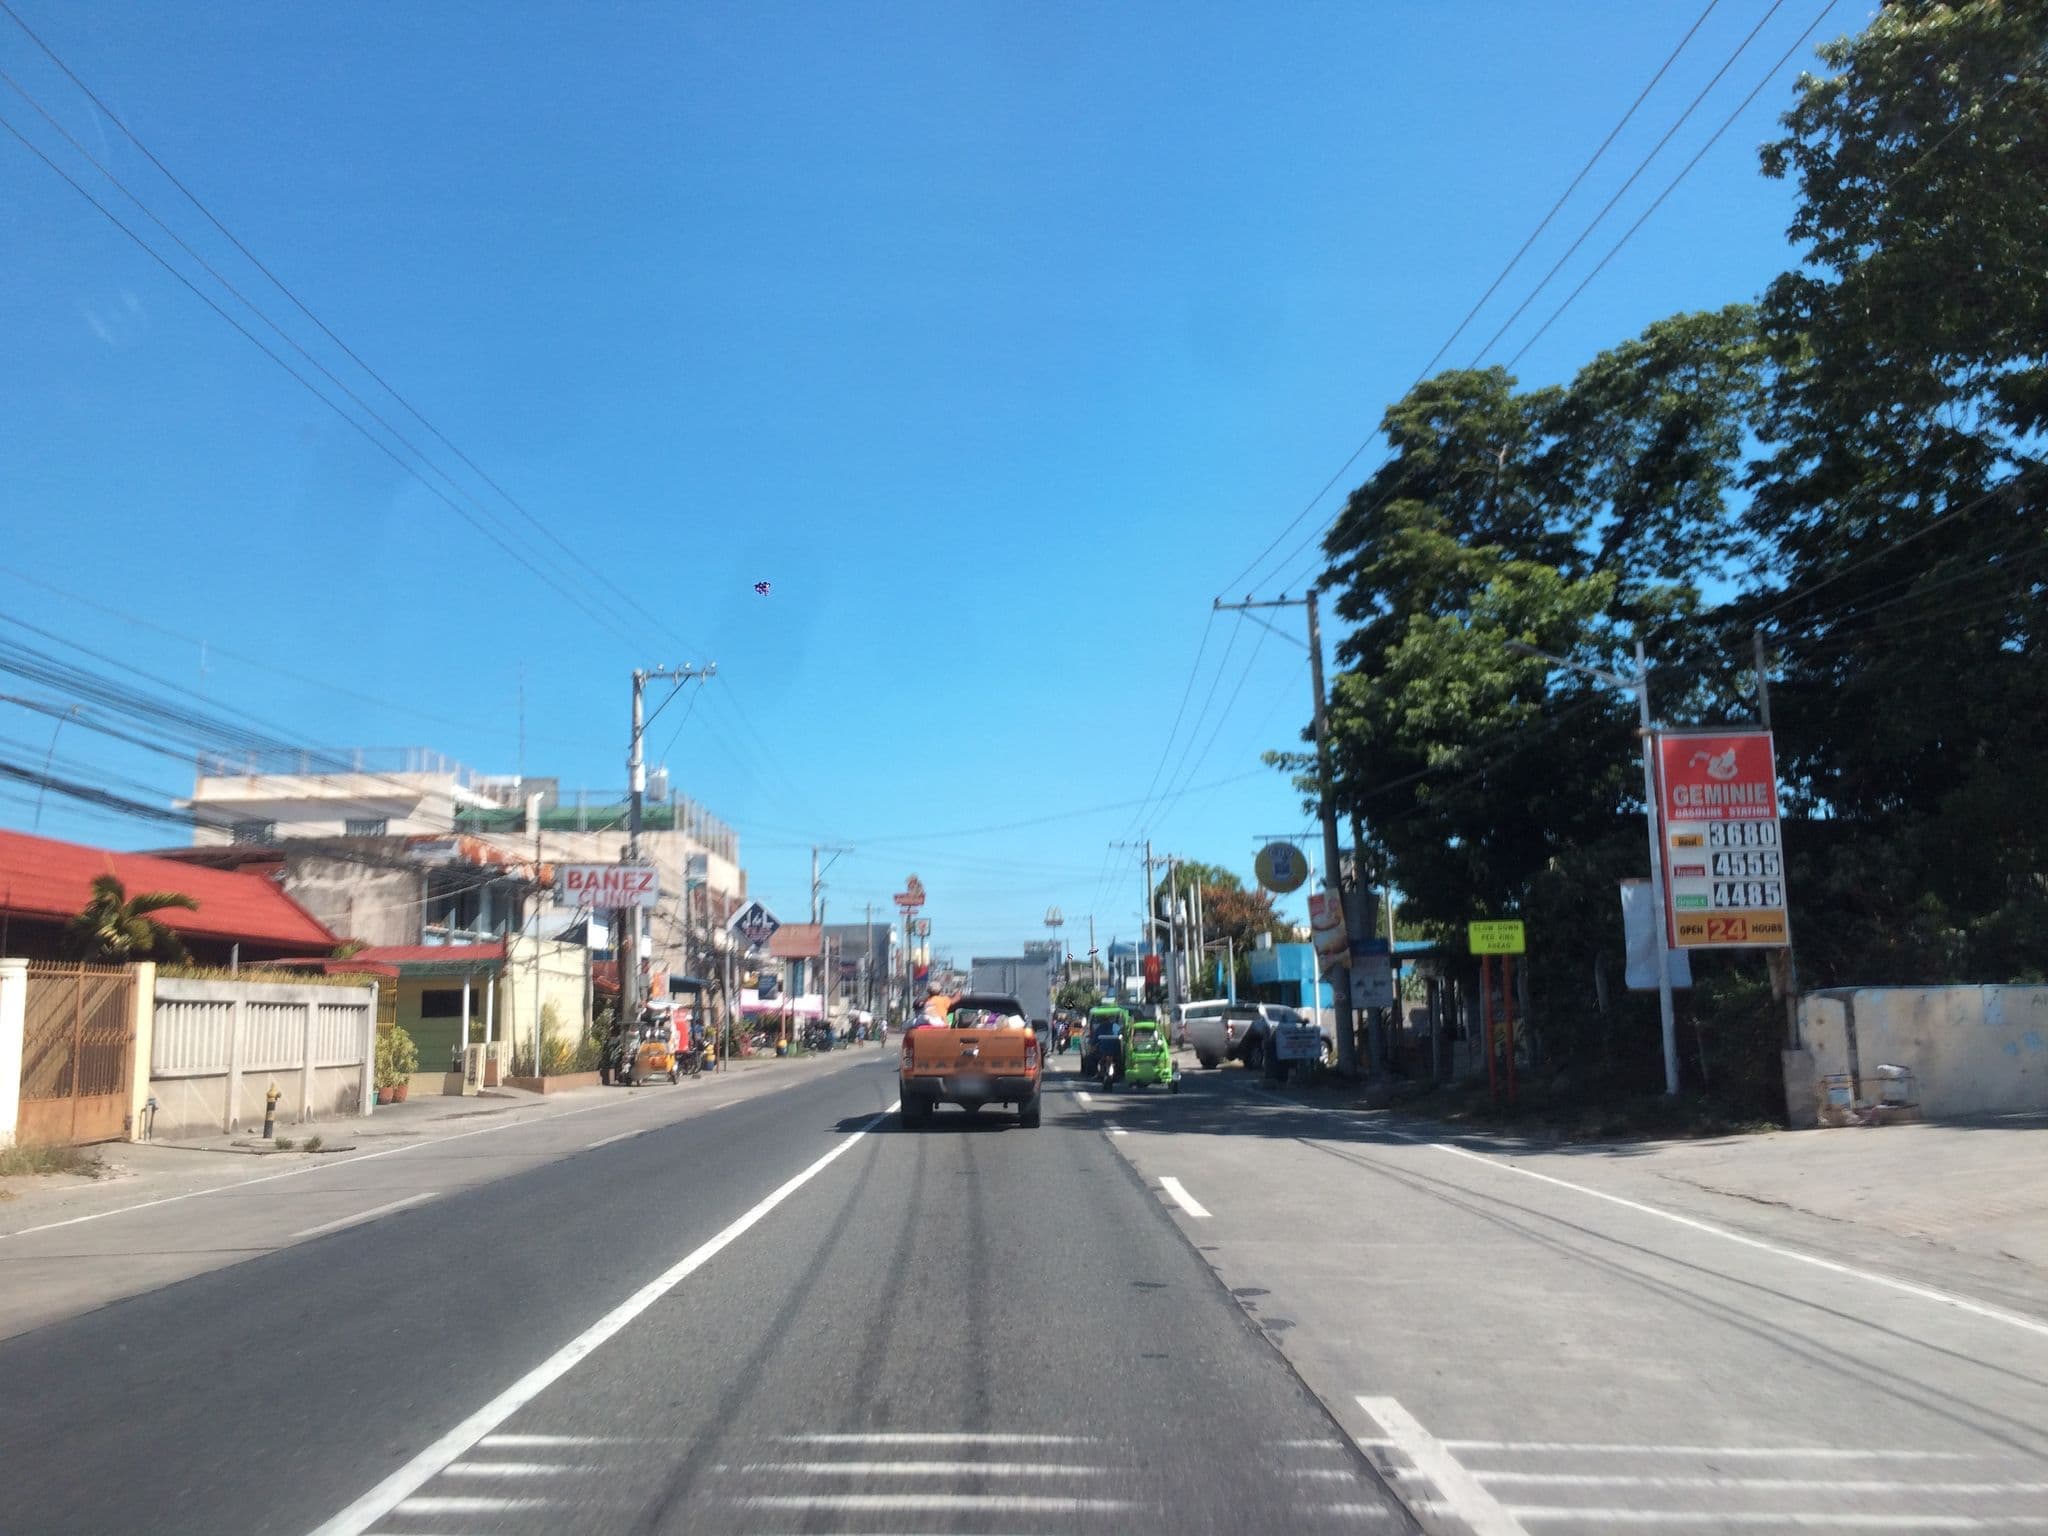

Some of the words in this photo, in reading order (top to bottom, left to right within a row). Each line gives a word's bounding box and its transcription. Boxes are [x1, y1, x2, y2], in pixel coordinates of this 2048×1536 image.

[1673, 783, 1768, 807] GEMINIE
[1675, 806, 1722, 818] GASOLINE
[1729, 804, 1770, 817] STATION
[1709, 821, 1775, 847] 3680
[1716, 852, 1779, 876] 4555
[1715, 881, 1780, 907] 4485
[1680, 924, 1703, 935] OPEN
[1709, 918, 1747, 941] 24
[1752, 923, 1783, 934] HOURS
